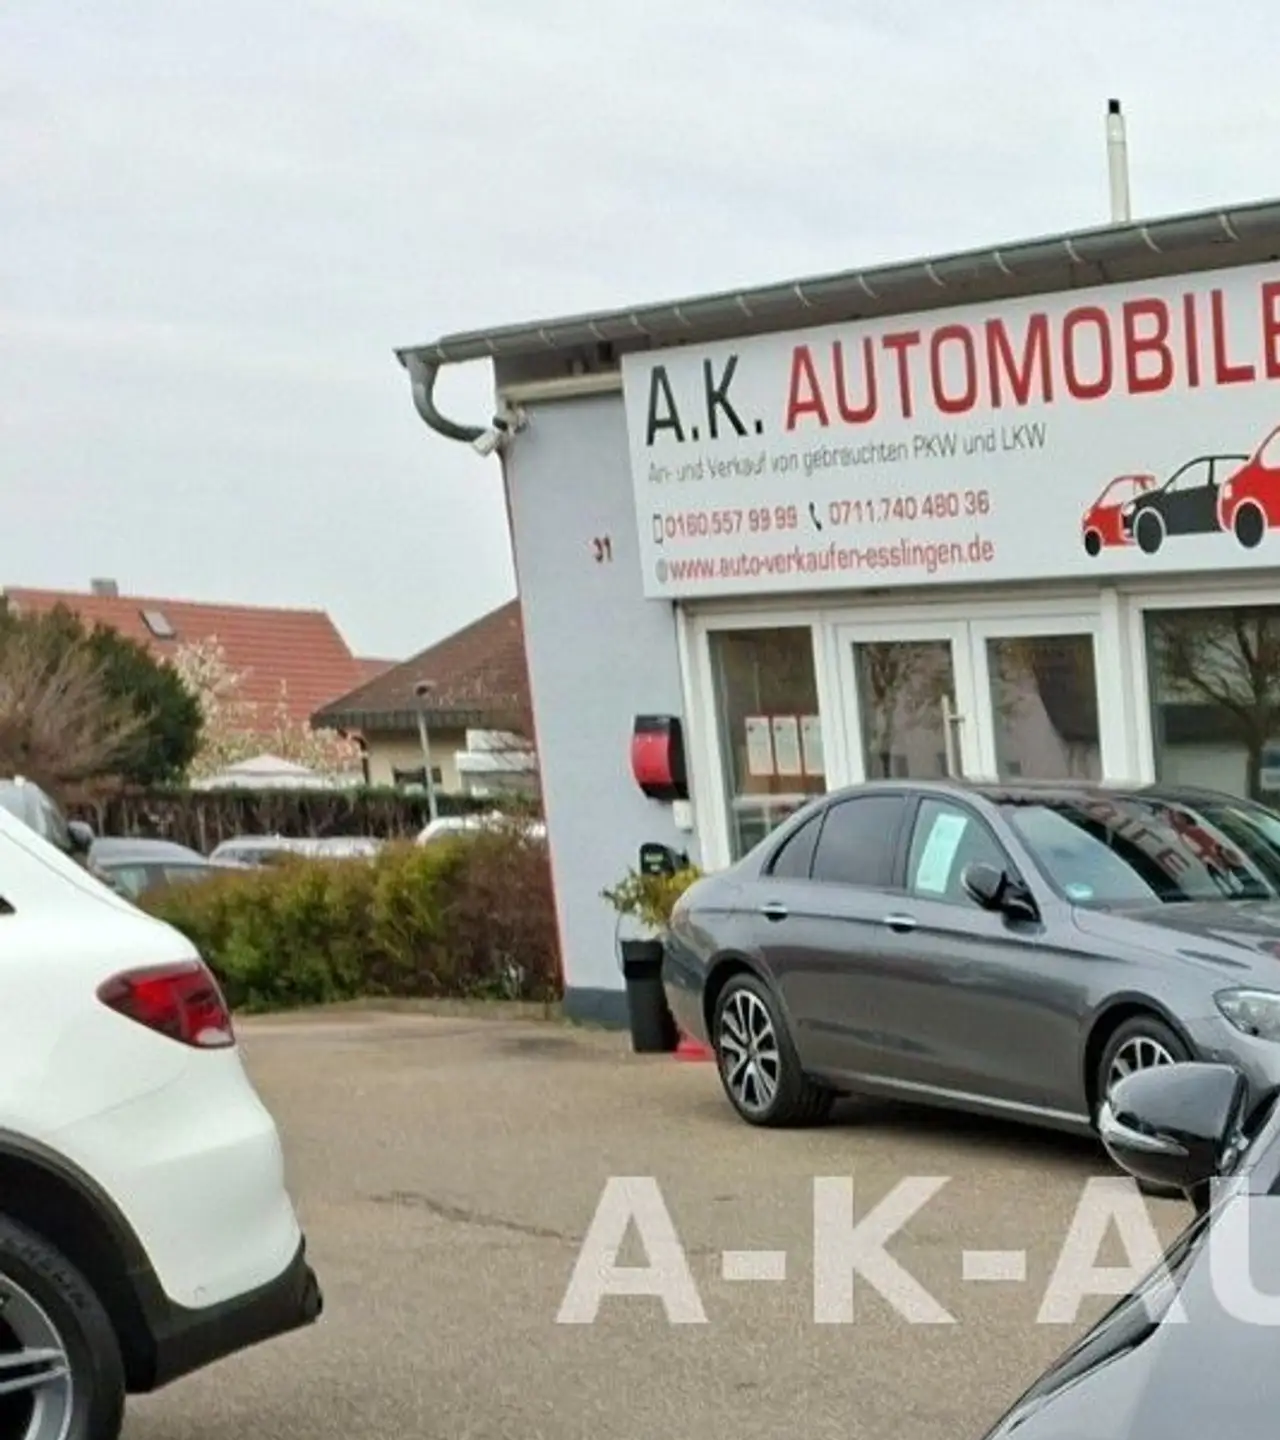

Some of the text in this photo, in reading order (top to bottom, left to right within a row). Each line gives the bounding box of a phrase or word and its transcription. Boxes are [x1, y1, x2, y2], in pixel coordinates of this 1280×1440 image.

[645, 354, 764, 446] A.K.
[771, 453, 798, 473] von
[803, 440, 909, 477] gebrauchten
[914, 432, 957, 459] PKW
[963, 427, 996, 455] und
[1002, 422, 1046, 450] LKW
[964, 489, 990, 515] 36
[669, 531, 995, 579] www.auto-verkaufen-esslingen.de
